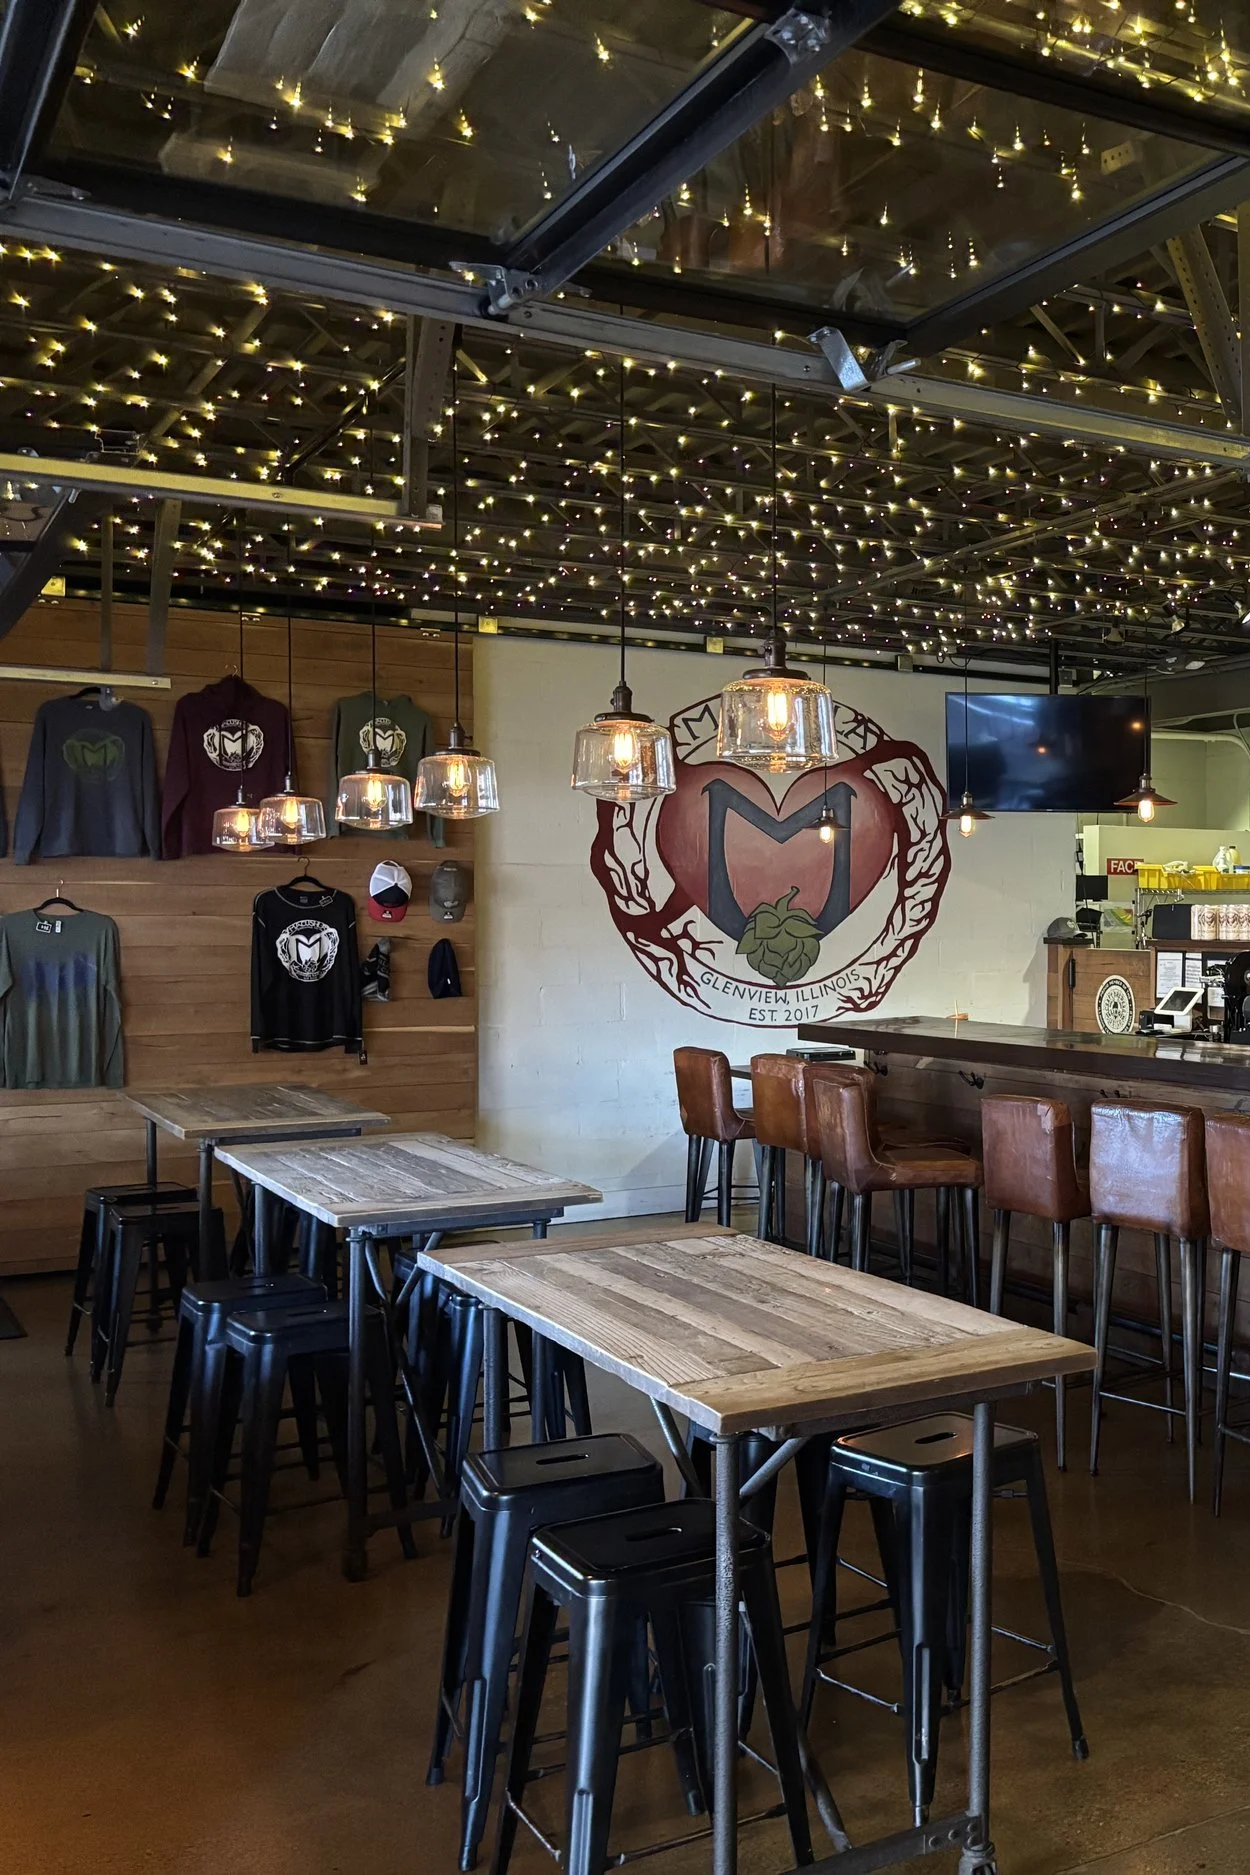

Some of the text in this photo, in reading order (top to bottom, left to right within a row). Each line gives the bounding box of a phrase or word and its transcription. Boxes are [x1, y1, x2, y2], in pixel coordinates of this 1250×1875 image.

[1110, 860, 1138, 874] FAC
[700, 968, 861, 1004] GLENVIEW, ILLINOIS
[748, 1005, 820, 1022] EST. 2017
